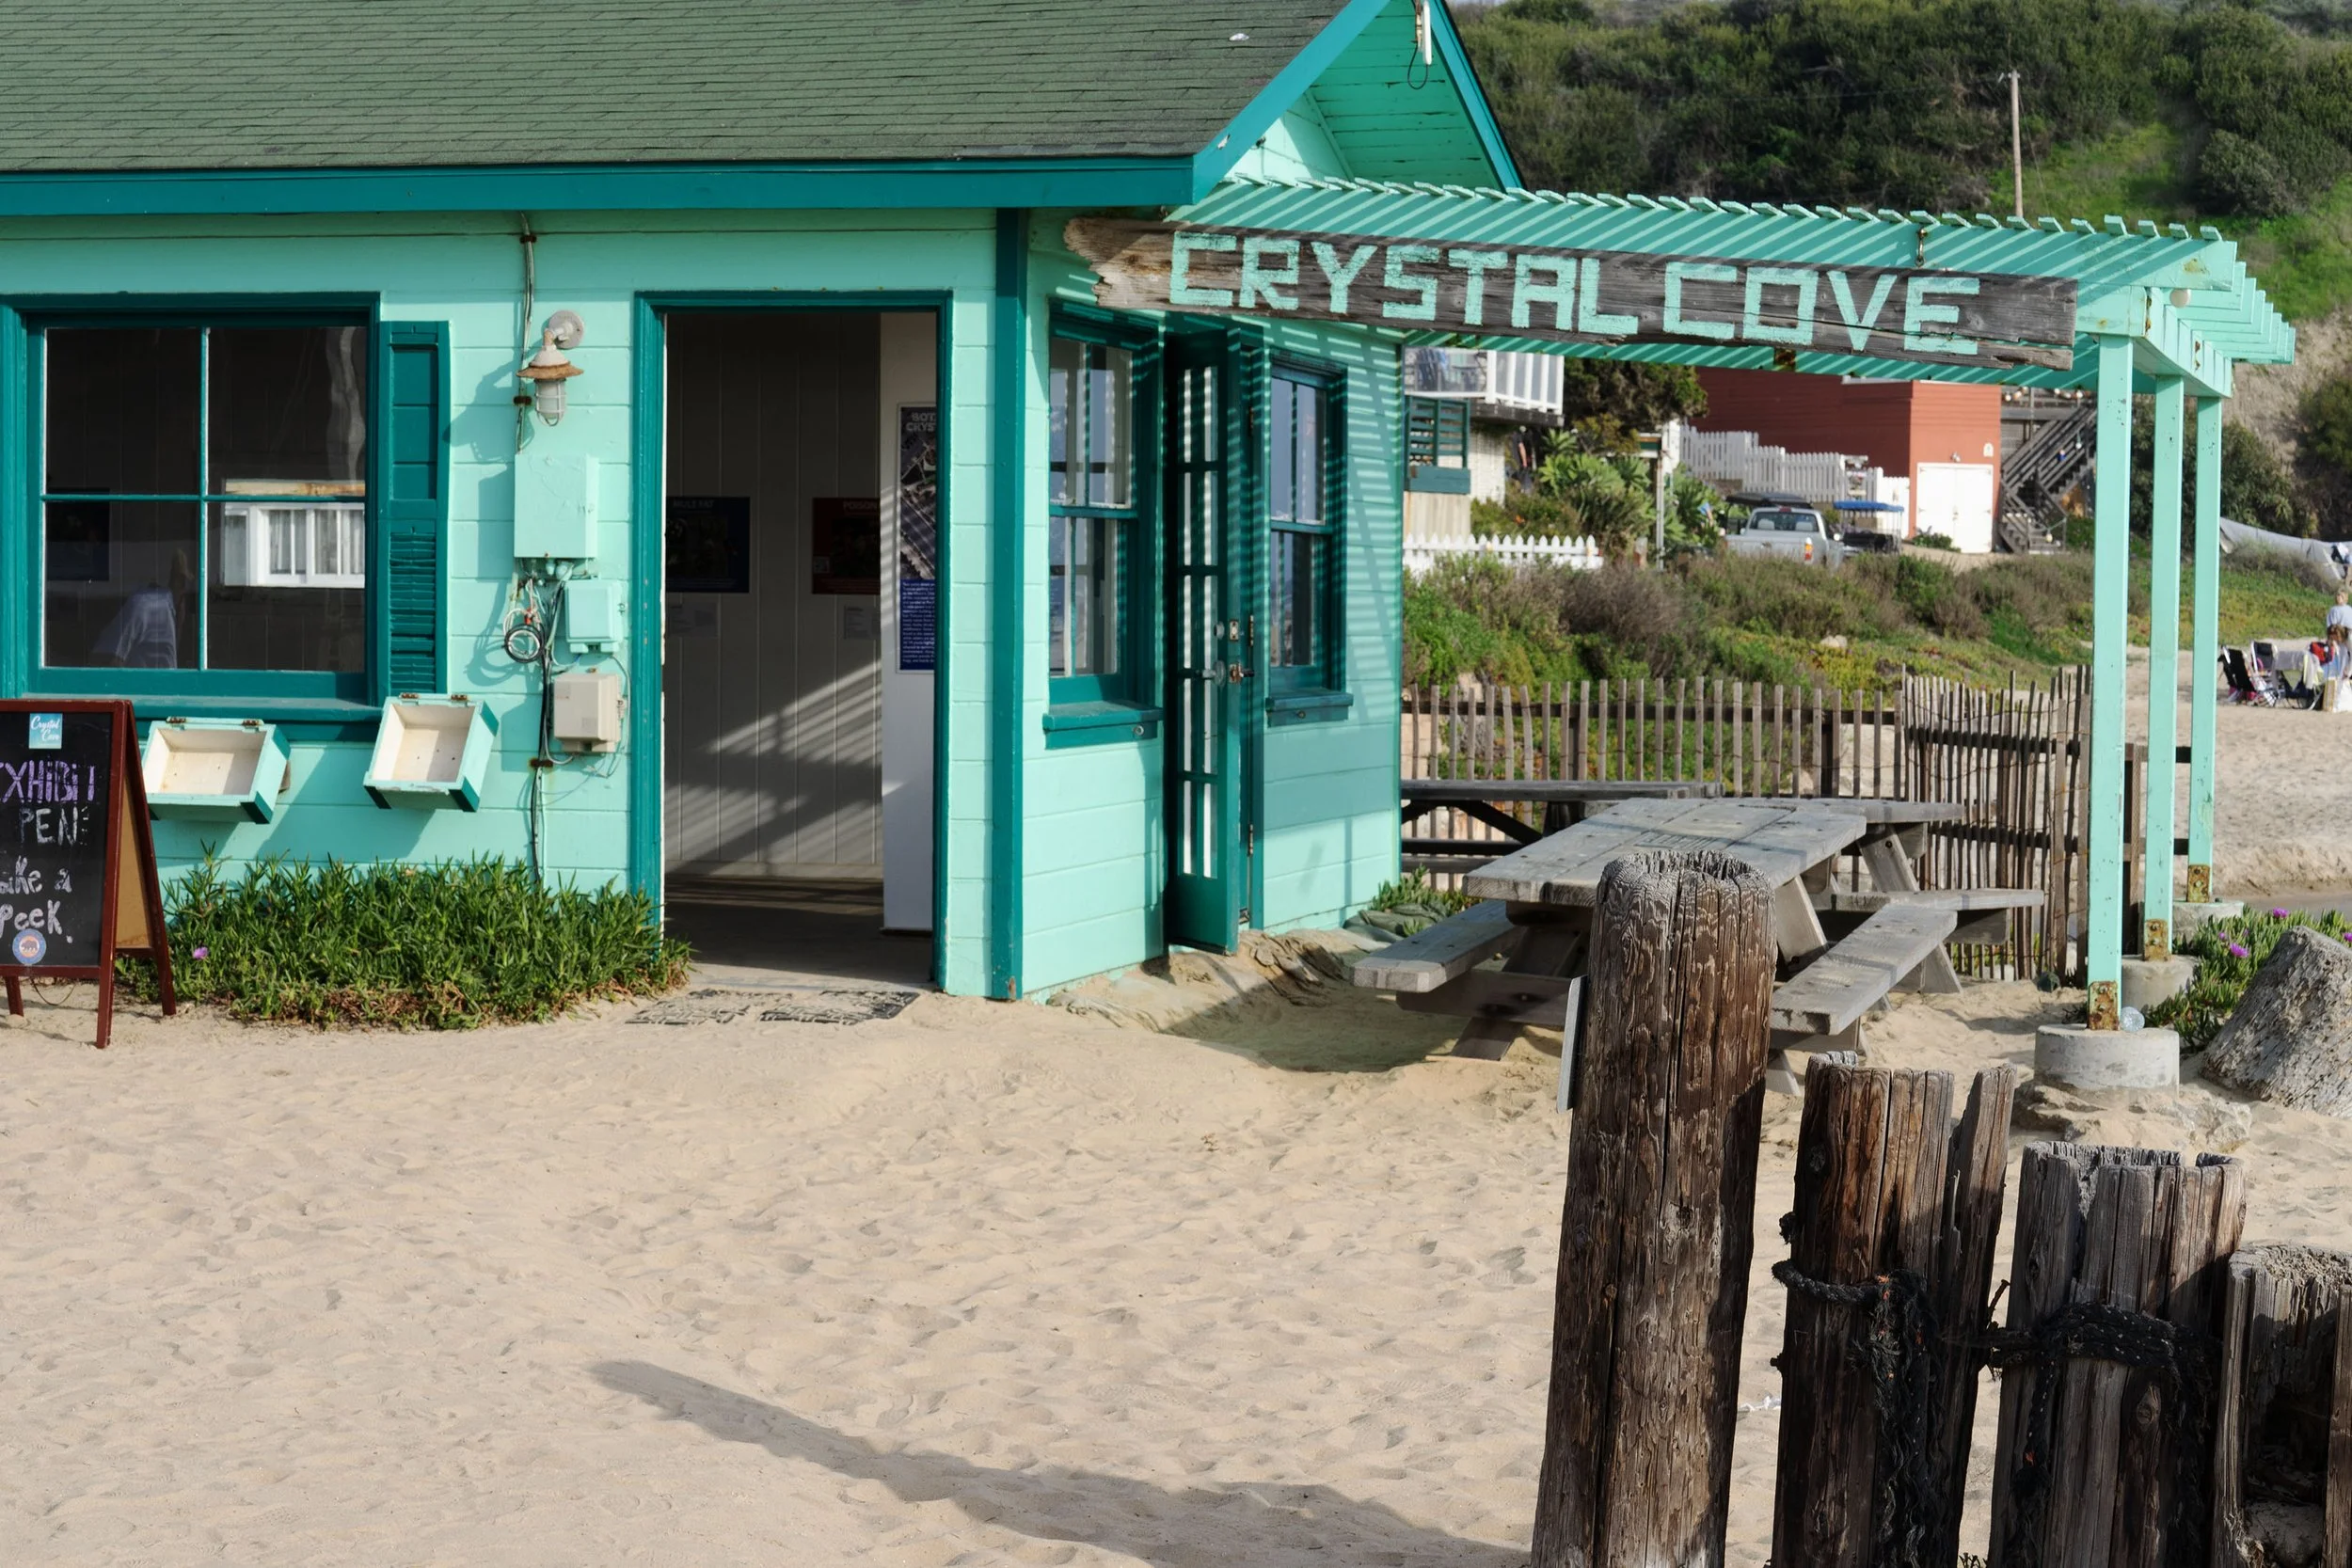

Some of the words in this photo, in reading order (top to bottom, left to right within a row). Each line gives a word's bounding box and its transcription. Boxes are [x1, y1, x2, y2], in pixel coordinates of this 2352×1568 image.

[1169, 231, 1640, 336] CRYSTAL
[1661, 261, 1980, 354] COVE
[30, 715, 60, 734] Crystal
